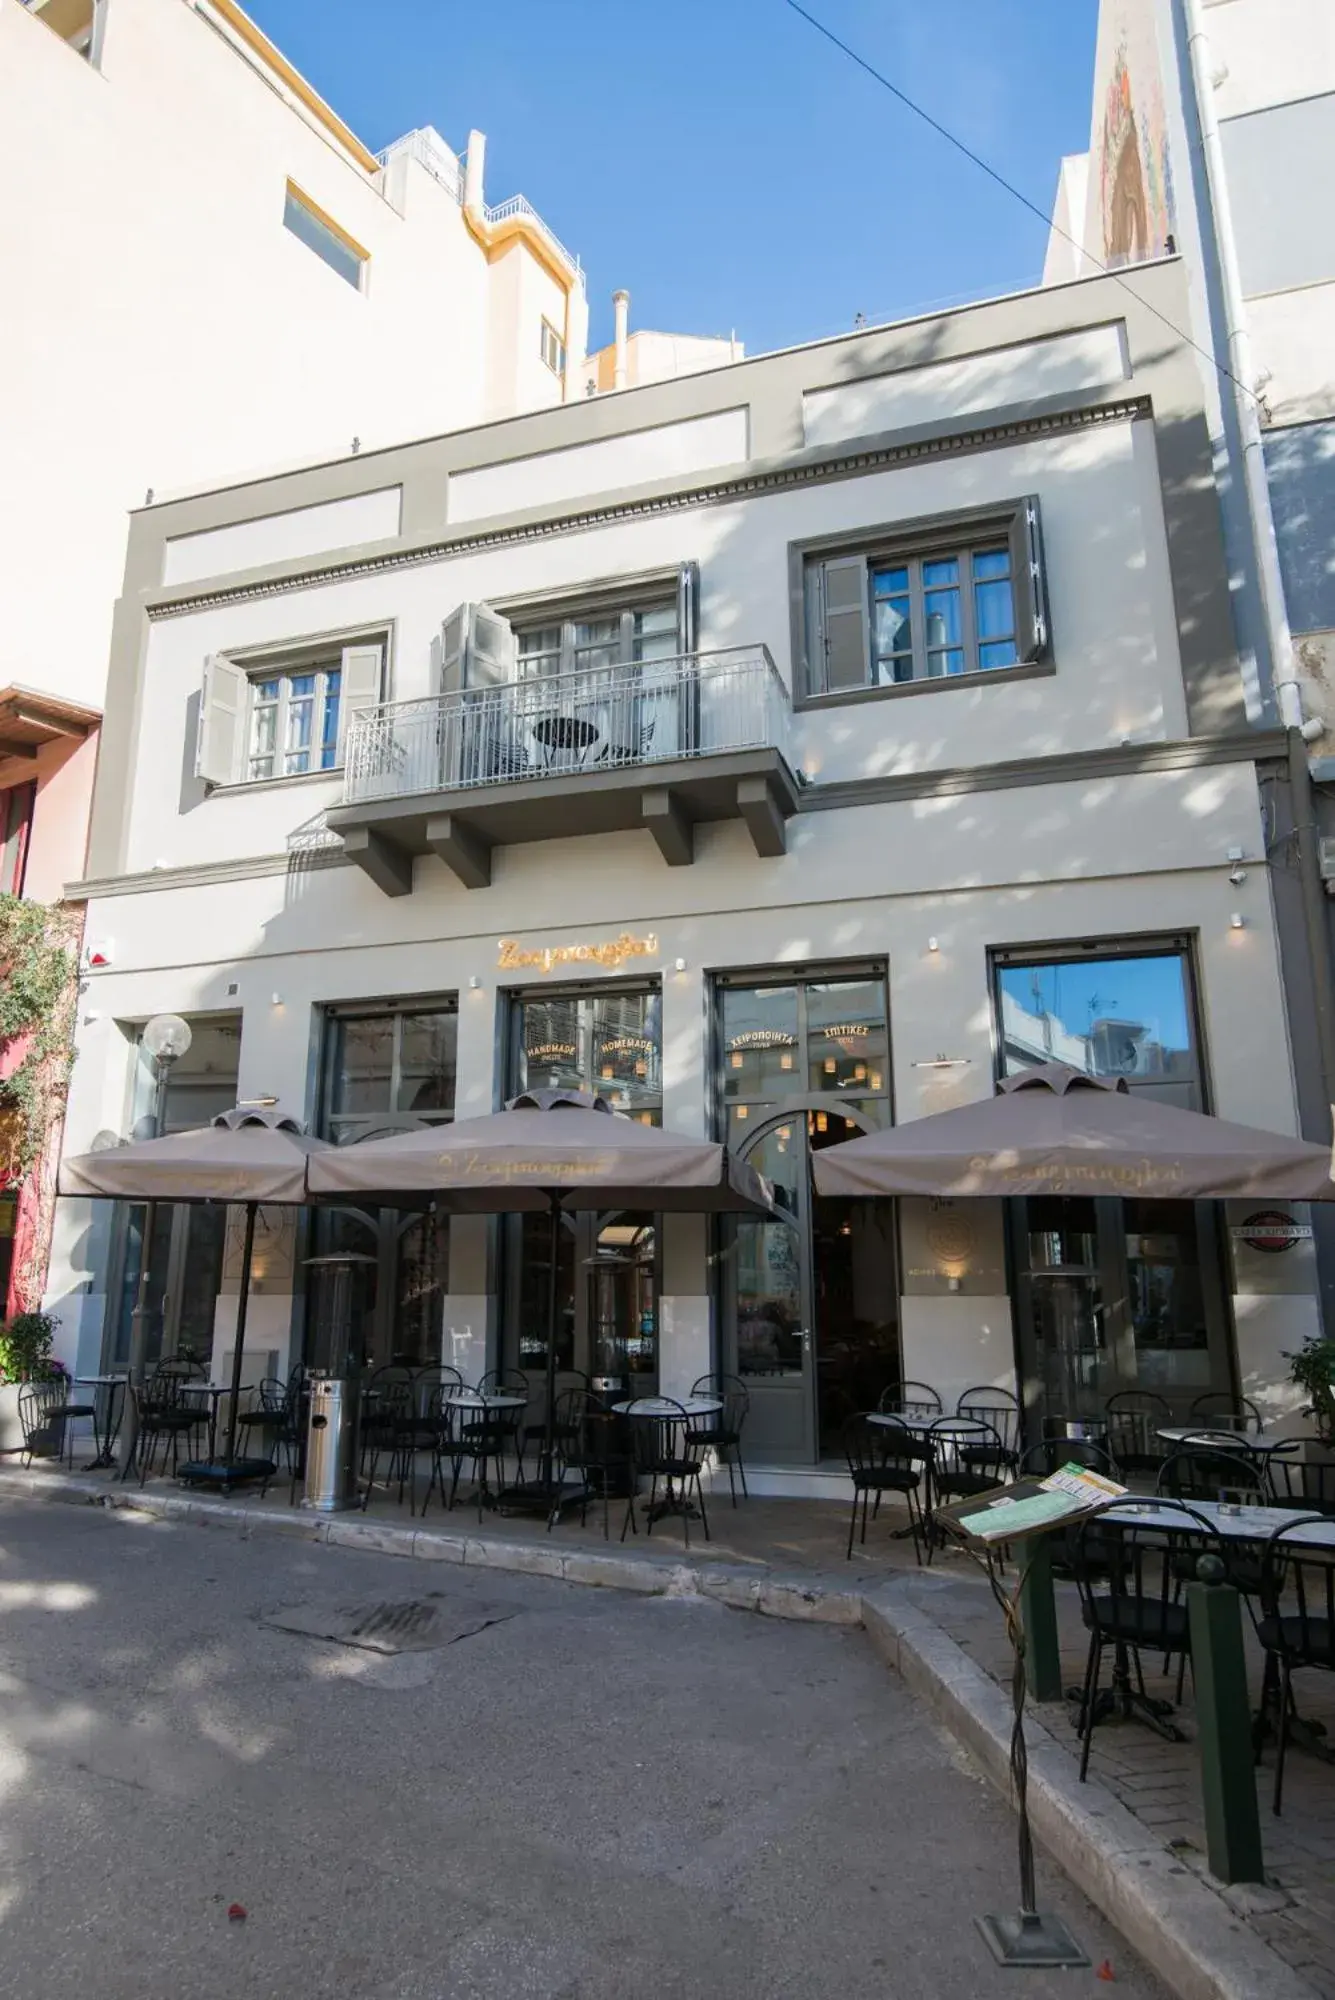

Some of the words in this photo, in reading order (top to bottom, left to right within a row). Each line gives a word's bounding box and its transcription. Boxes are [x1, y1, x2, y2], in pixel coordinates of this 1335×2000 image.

[824, 1024, 869, 1038] ΣΠΙΤΙΚΕΣ
[601, 1038, 652, 1053] HOMEMADE
[731, 1030, 793, 1048] ΧΕΙΡΟΠΟΙΗΤΑ
[528, 1043, 575, 1057] HANDMADE
